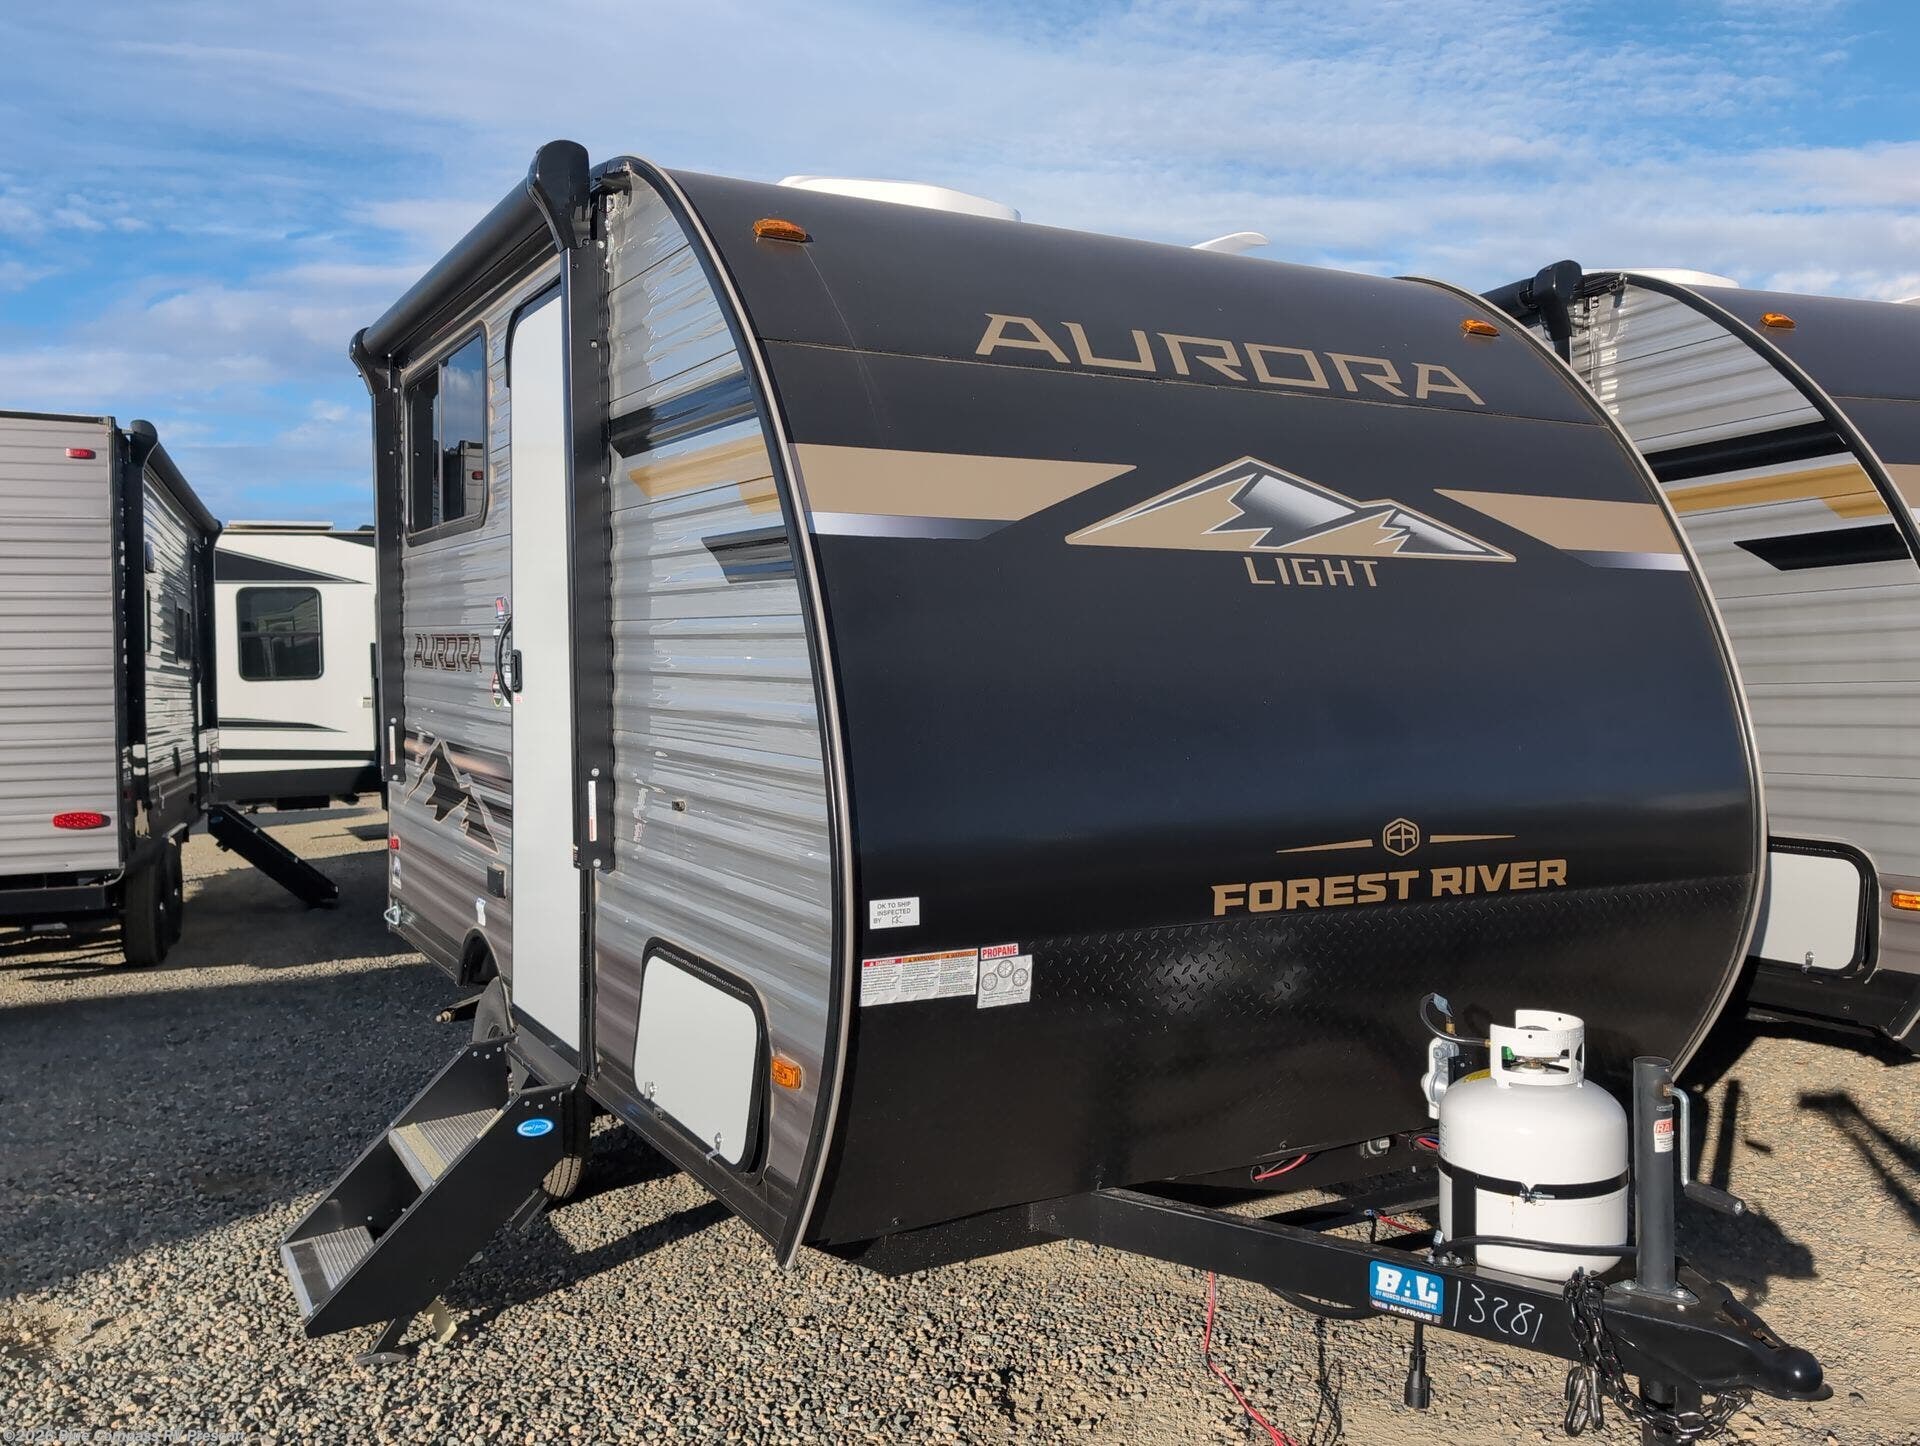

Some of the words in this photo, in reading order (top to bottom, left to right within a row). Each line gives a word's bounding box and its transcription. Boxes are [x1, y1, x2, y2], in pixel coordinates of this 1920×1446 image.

[975, 313, 1485, 405] AURORA
[1243, 557, 1378, 587] LIGHT
[414, 633, 482, 673] AURORA
[1210, 870, 1420, 916] FOREST
[1429, 858, 1567, 897] RIVER
[877, 907, 911, 917] INSPECTED
[982, 944, 1017, 959] PROPANE
[1376, 1265, 1438, 1304] BAL
